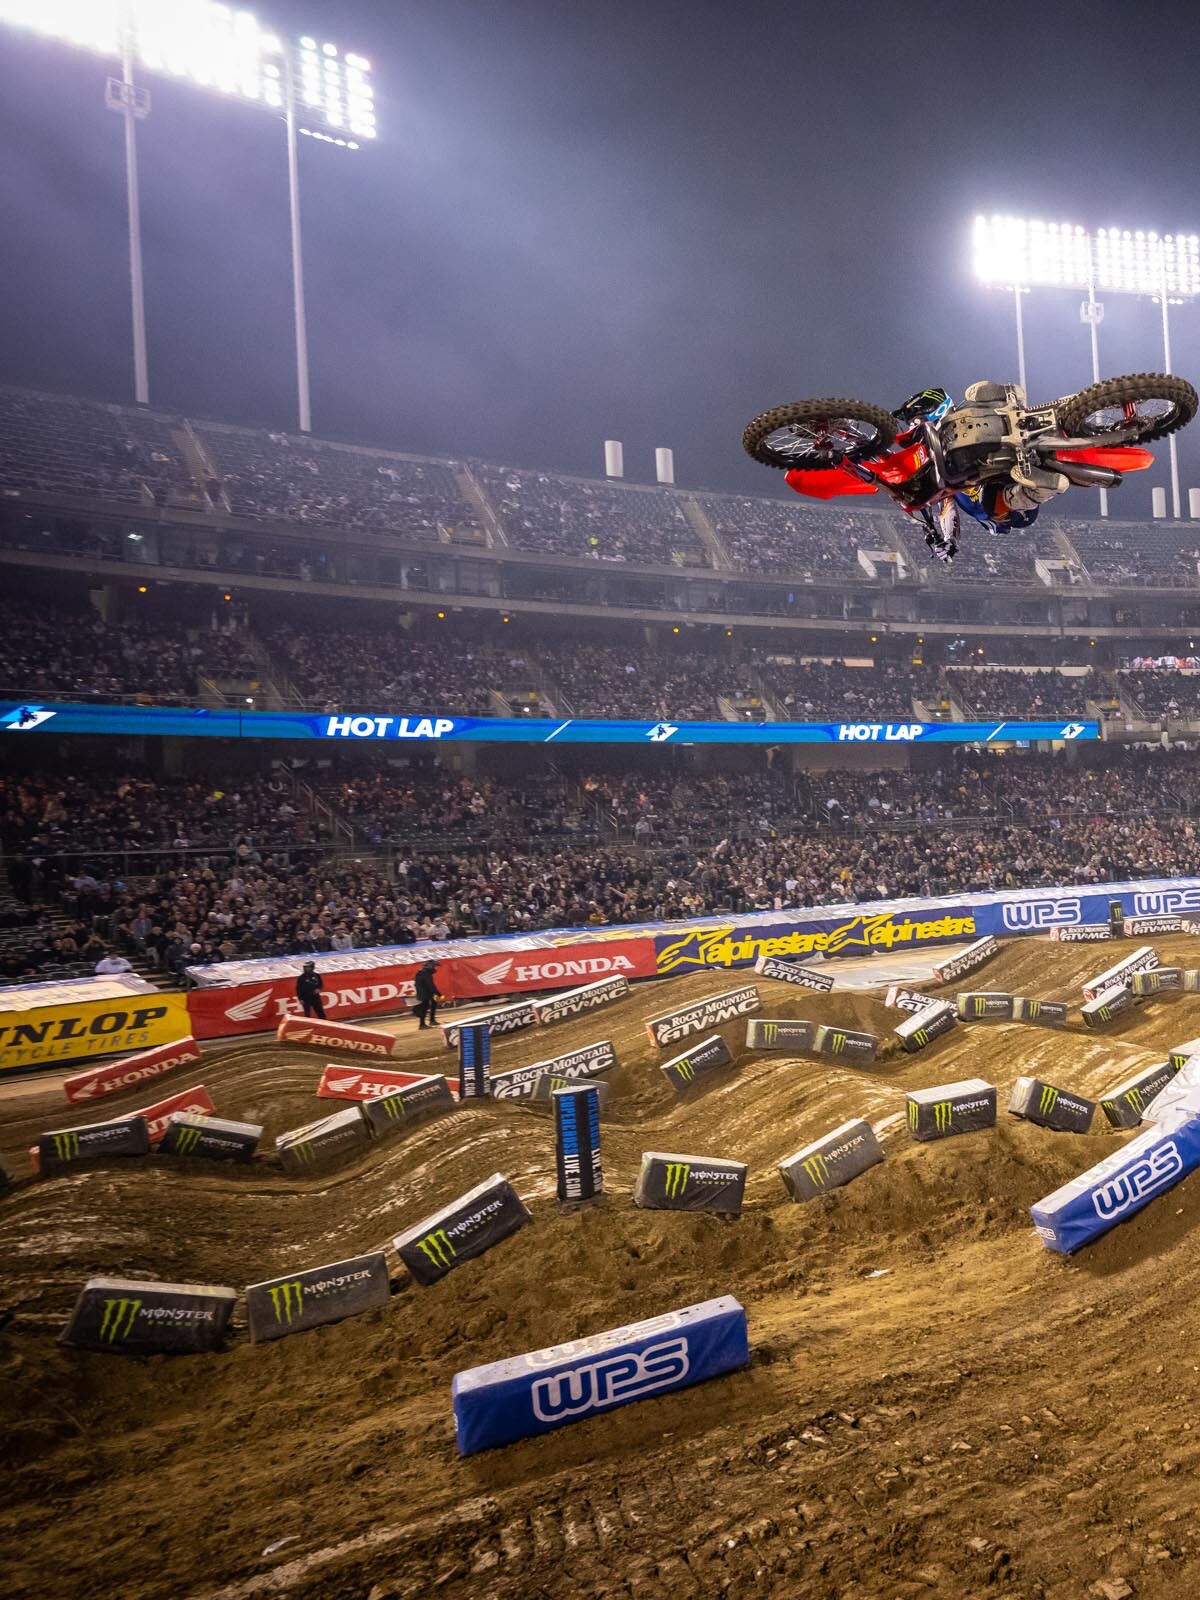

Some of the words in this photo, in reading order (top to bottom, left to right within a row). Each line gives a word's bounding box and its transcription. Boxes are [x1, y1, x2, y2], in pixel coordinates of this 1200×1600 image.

[326, 716, 392, 737] HOT
[398, 719, 454, 738] LAP
[839, 725, 879, 740] HOT
[885, 725, 923, 740] LAP
[1002, 899, 1082, 930] WPS
[870, 915, 976, 947] alpinestars
[706, 933, 829, 966] alpinestars
[515, 955, 635, 982] HONDA
[554, 996, 580, 1010] ROCKY
[582, 980, 625, 999] MOUNTAIN
[672, 1010, 703, 1026] ROCKY
[705, 989, 756, 1014] MOUNTAIN
[494, 1008, 532, 1024] MOUNTA
[87, 1031, 149, 1049] TIRES
[310, 1034, 389, 1055] HONDA
[104, 1052, 199, 1092] HONDA
[512, 1065, 550, 1083] ROCKY
[552, 1044, 611, 1071] MOUNTAIN
[952, 1099, 989, 1113] MONSTER
[824, 1135, 865, 1164] MONSTER
[689, 1171, 739, 1181] MONSTER
[1092, 1141, 1183, 1219] WPS
[447, 1200, 502, 1238] MONSTER
[304, 1269, 372, 1295] MONSTER
[140, 1307, 213, 1322] MONSTER
[532, 1337, 689, 1422] WPS
